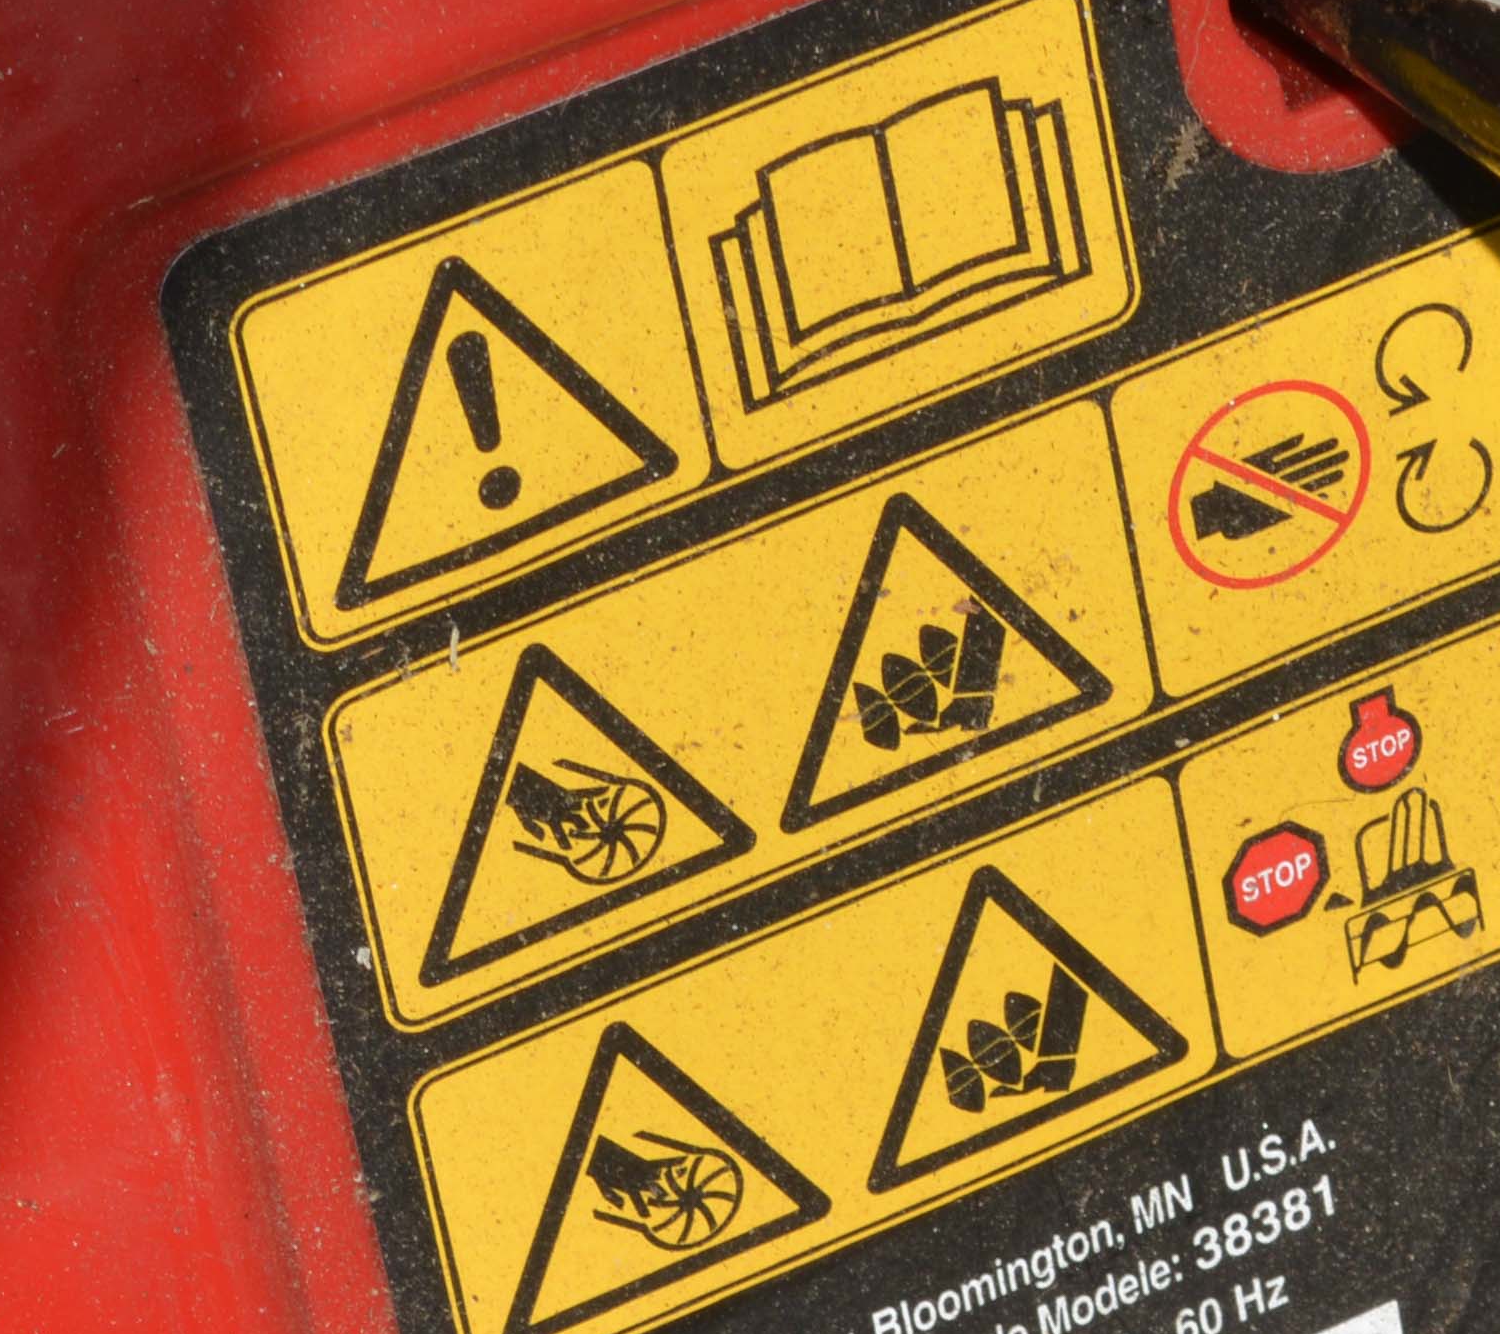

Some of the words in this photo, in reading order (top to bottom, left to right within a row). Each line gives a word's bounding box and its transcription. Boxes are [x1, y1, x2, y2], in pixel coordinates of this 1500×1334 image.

[1351, 728, 1411, 768] STOP
[1241, 852, 1312, 904] STOP
[1130, 1174, 1193, 1234] MN
[1221, 1119, 1336, 1191] U.S.A.
[1193, 1174, 1335, 1270] 38381
[1233, 1275, 1289, 1322] Hz
